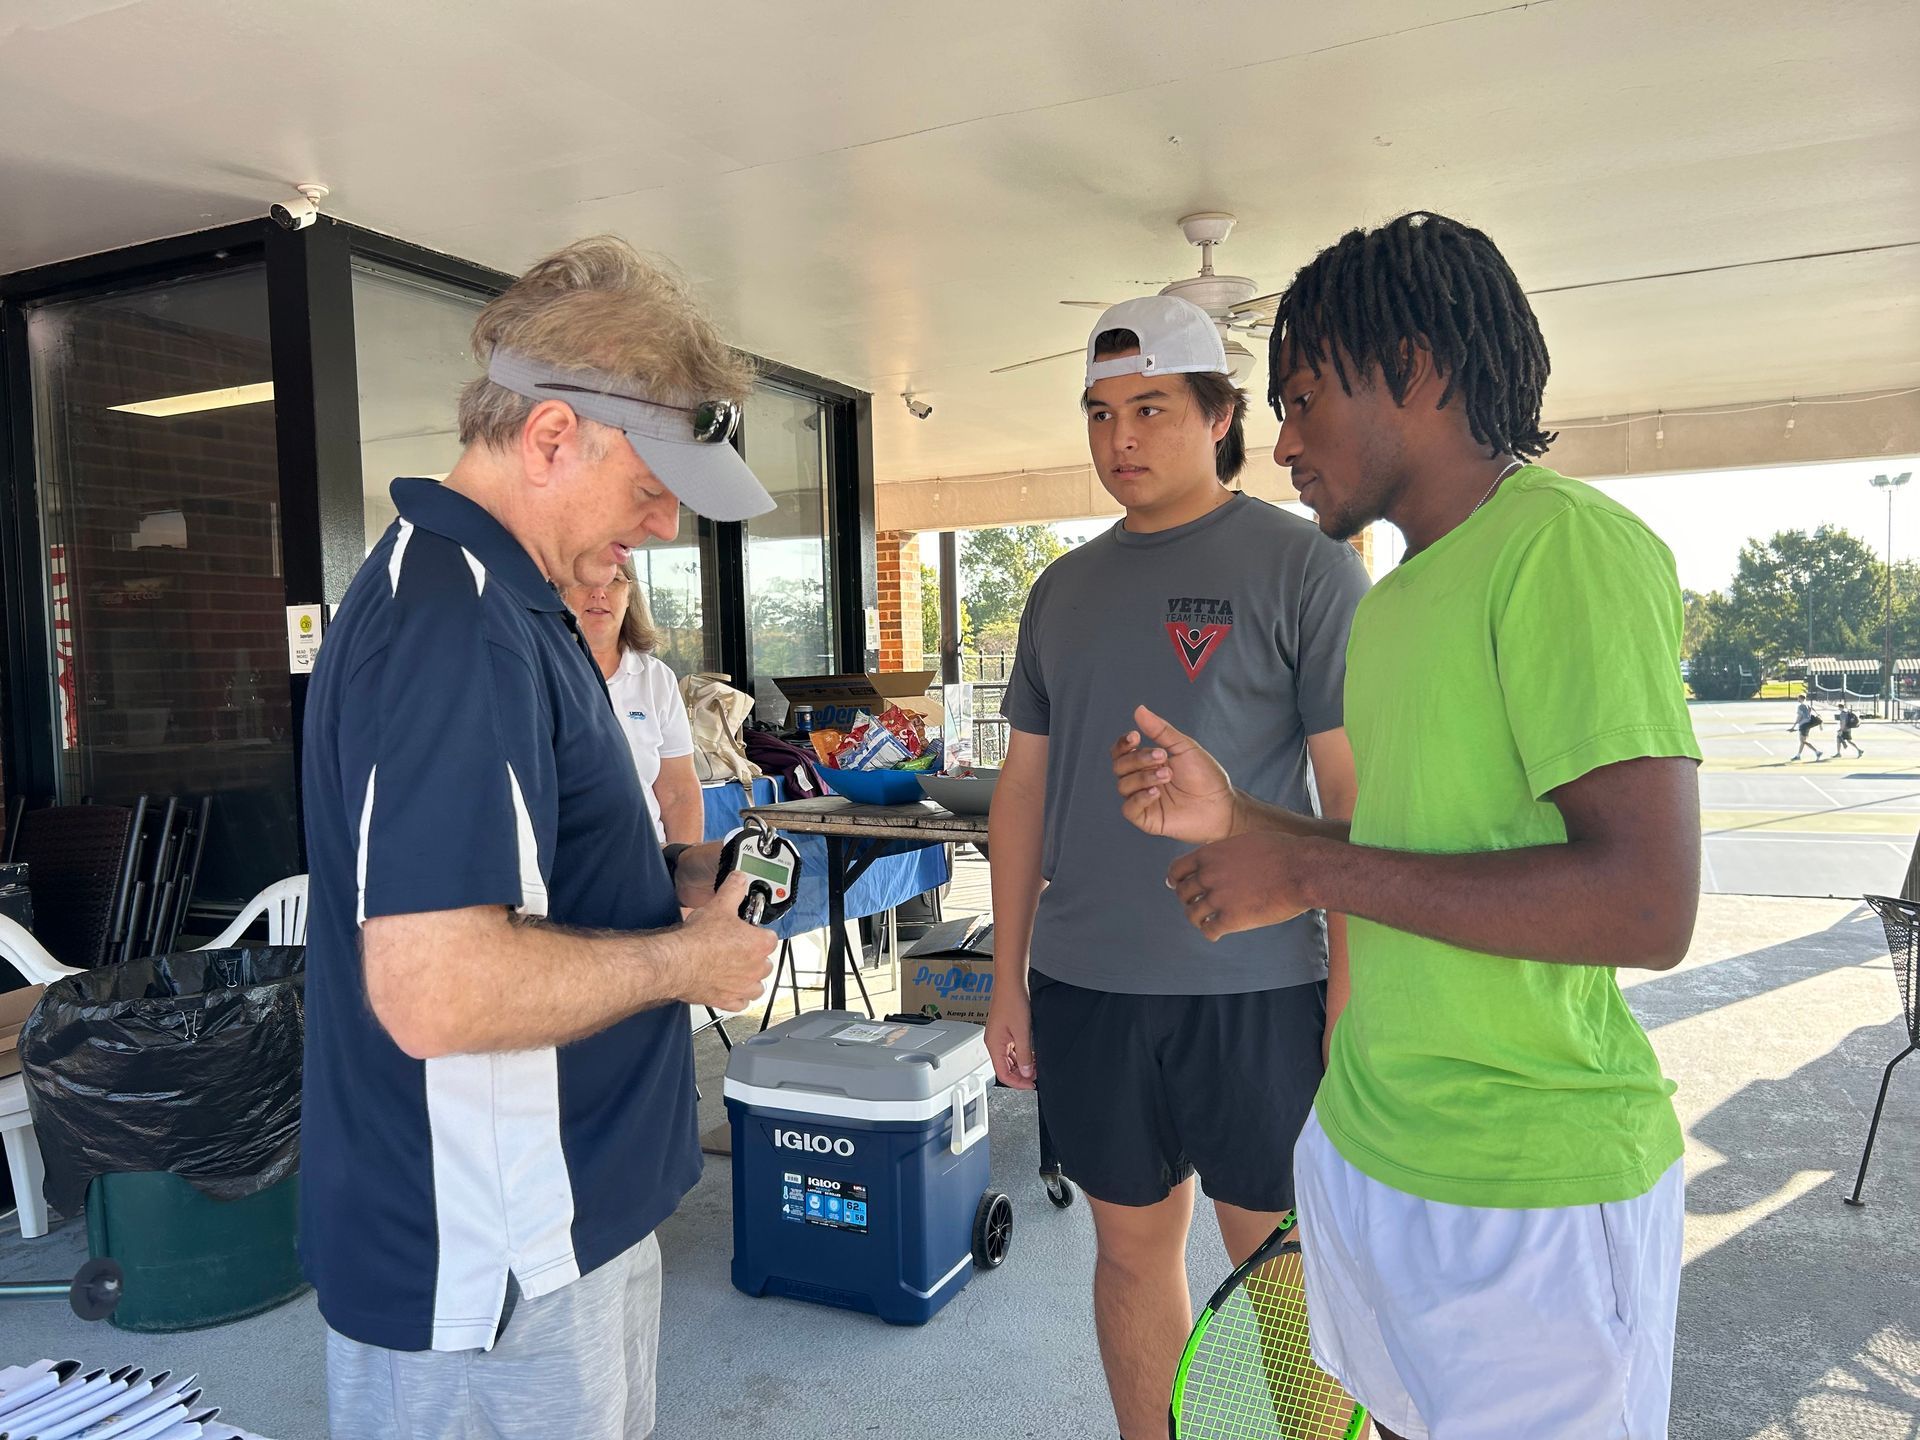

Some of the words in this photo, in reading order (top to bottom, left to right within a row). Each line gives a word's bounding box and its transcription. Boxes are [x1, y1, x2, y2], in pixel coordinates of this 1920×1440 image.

[1167, 597, 1233, 615] VETTA
[1165, 613, 1191, 622] TEAM
[1194, 614, 1234, 625] TENNIS
[912, 966, 993, 998] ProPen
[774, 1129, 855, 1157] IGLOO
[807, 1177, 841, 1190] IGLOO
[782, 1204, 791, 1214] 4
[846, 1201, 859, 1211] 62
